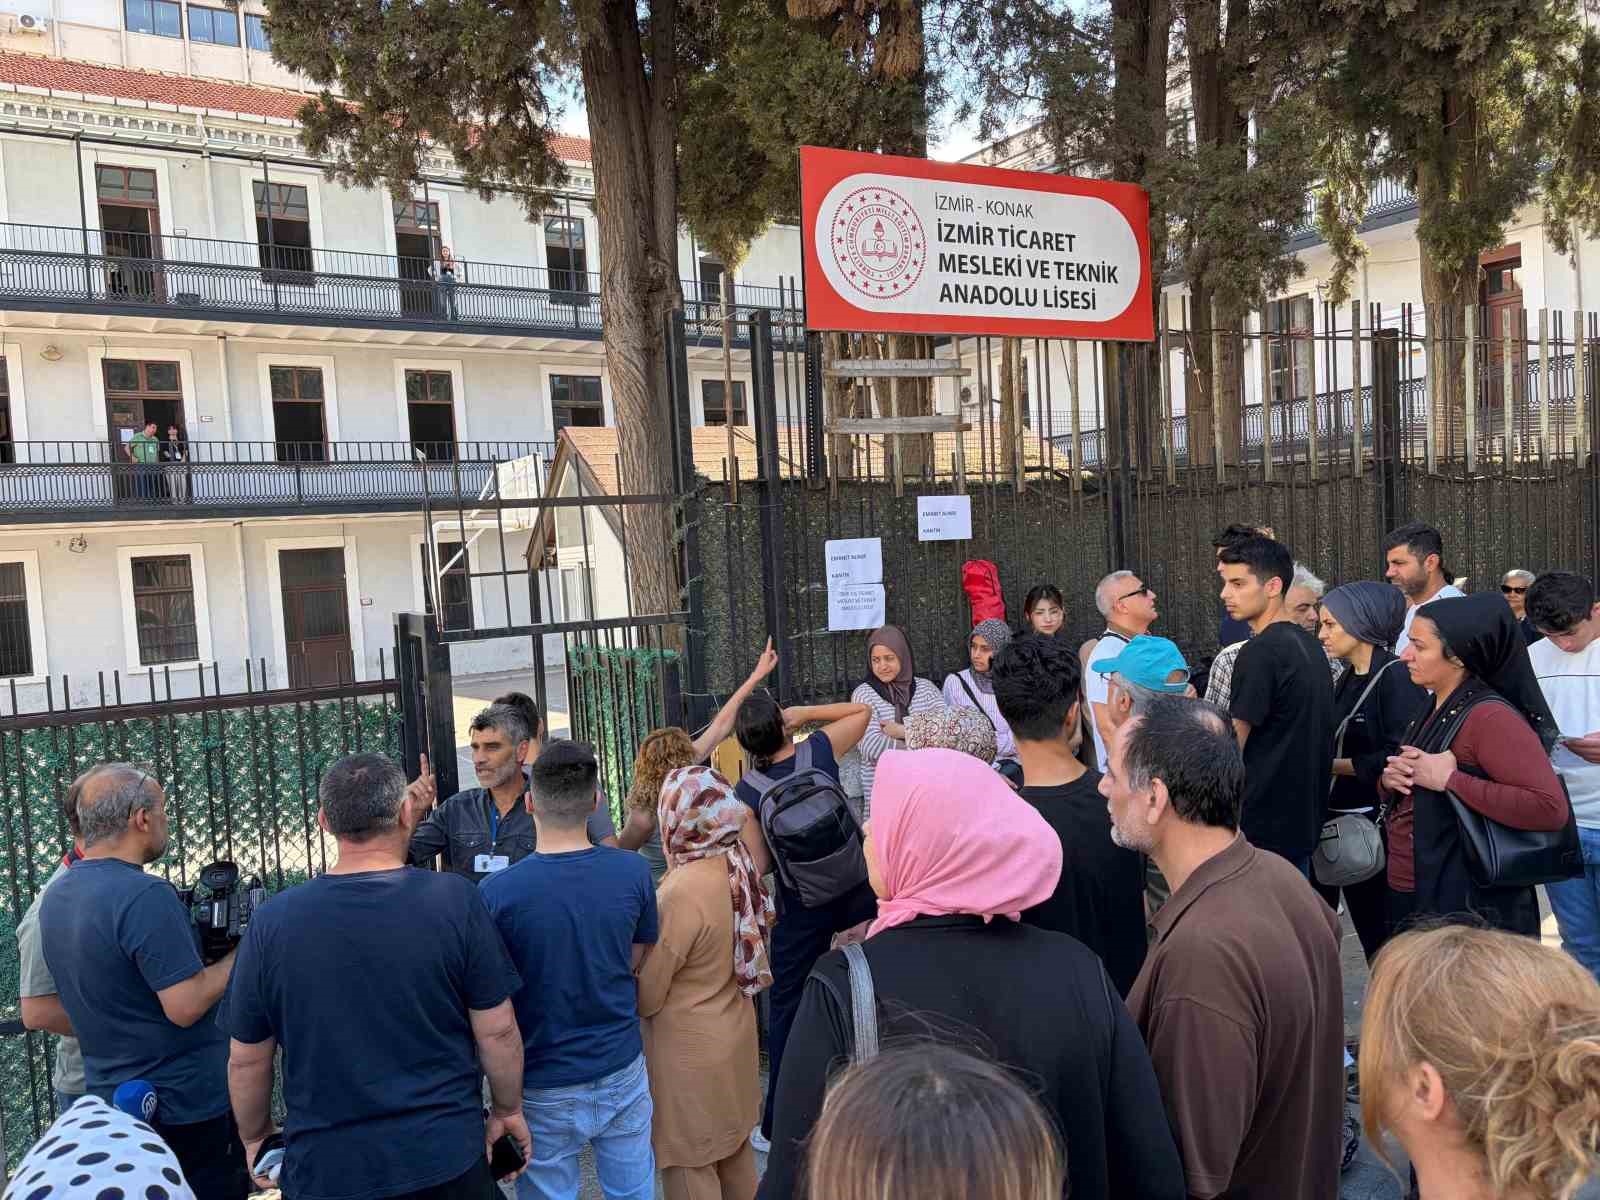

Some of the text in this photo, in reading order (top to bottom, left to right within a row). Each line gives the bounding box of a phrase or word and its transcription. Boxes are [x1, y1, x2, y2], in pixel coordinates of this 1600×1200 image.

[935, 192, 974, 213] İZMİR
[986, 199, 1034, 219] KONAK
[937, 218, 1076, 252] İZMİR TİCARET
[938, 253, 1119, 285] MESLEKİ VE TEKNİK
[939, 283, 1097, 311] ANADOLU LİSESİ
